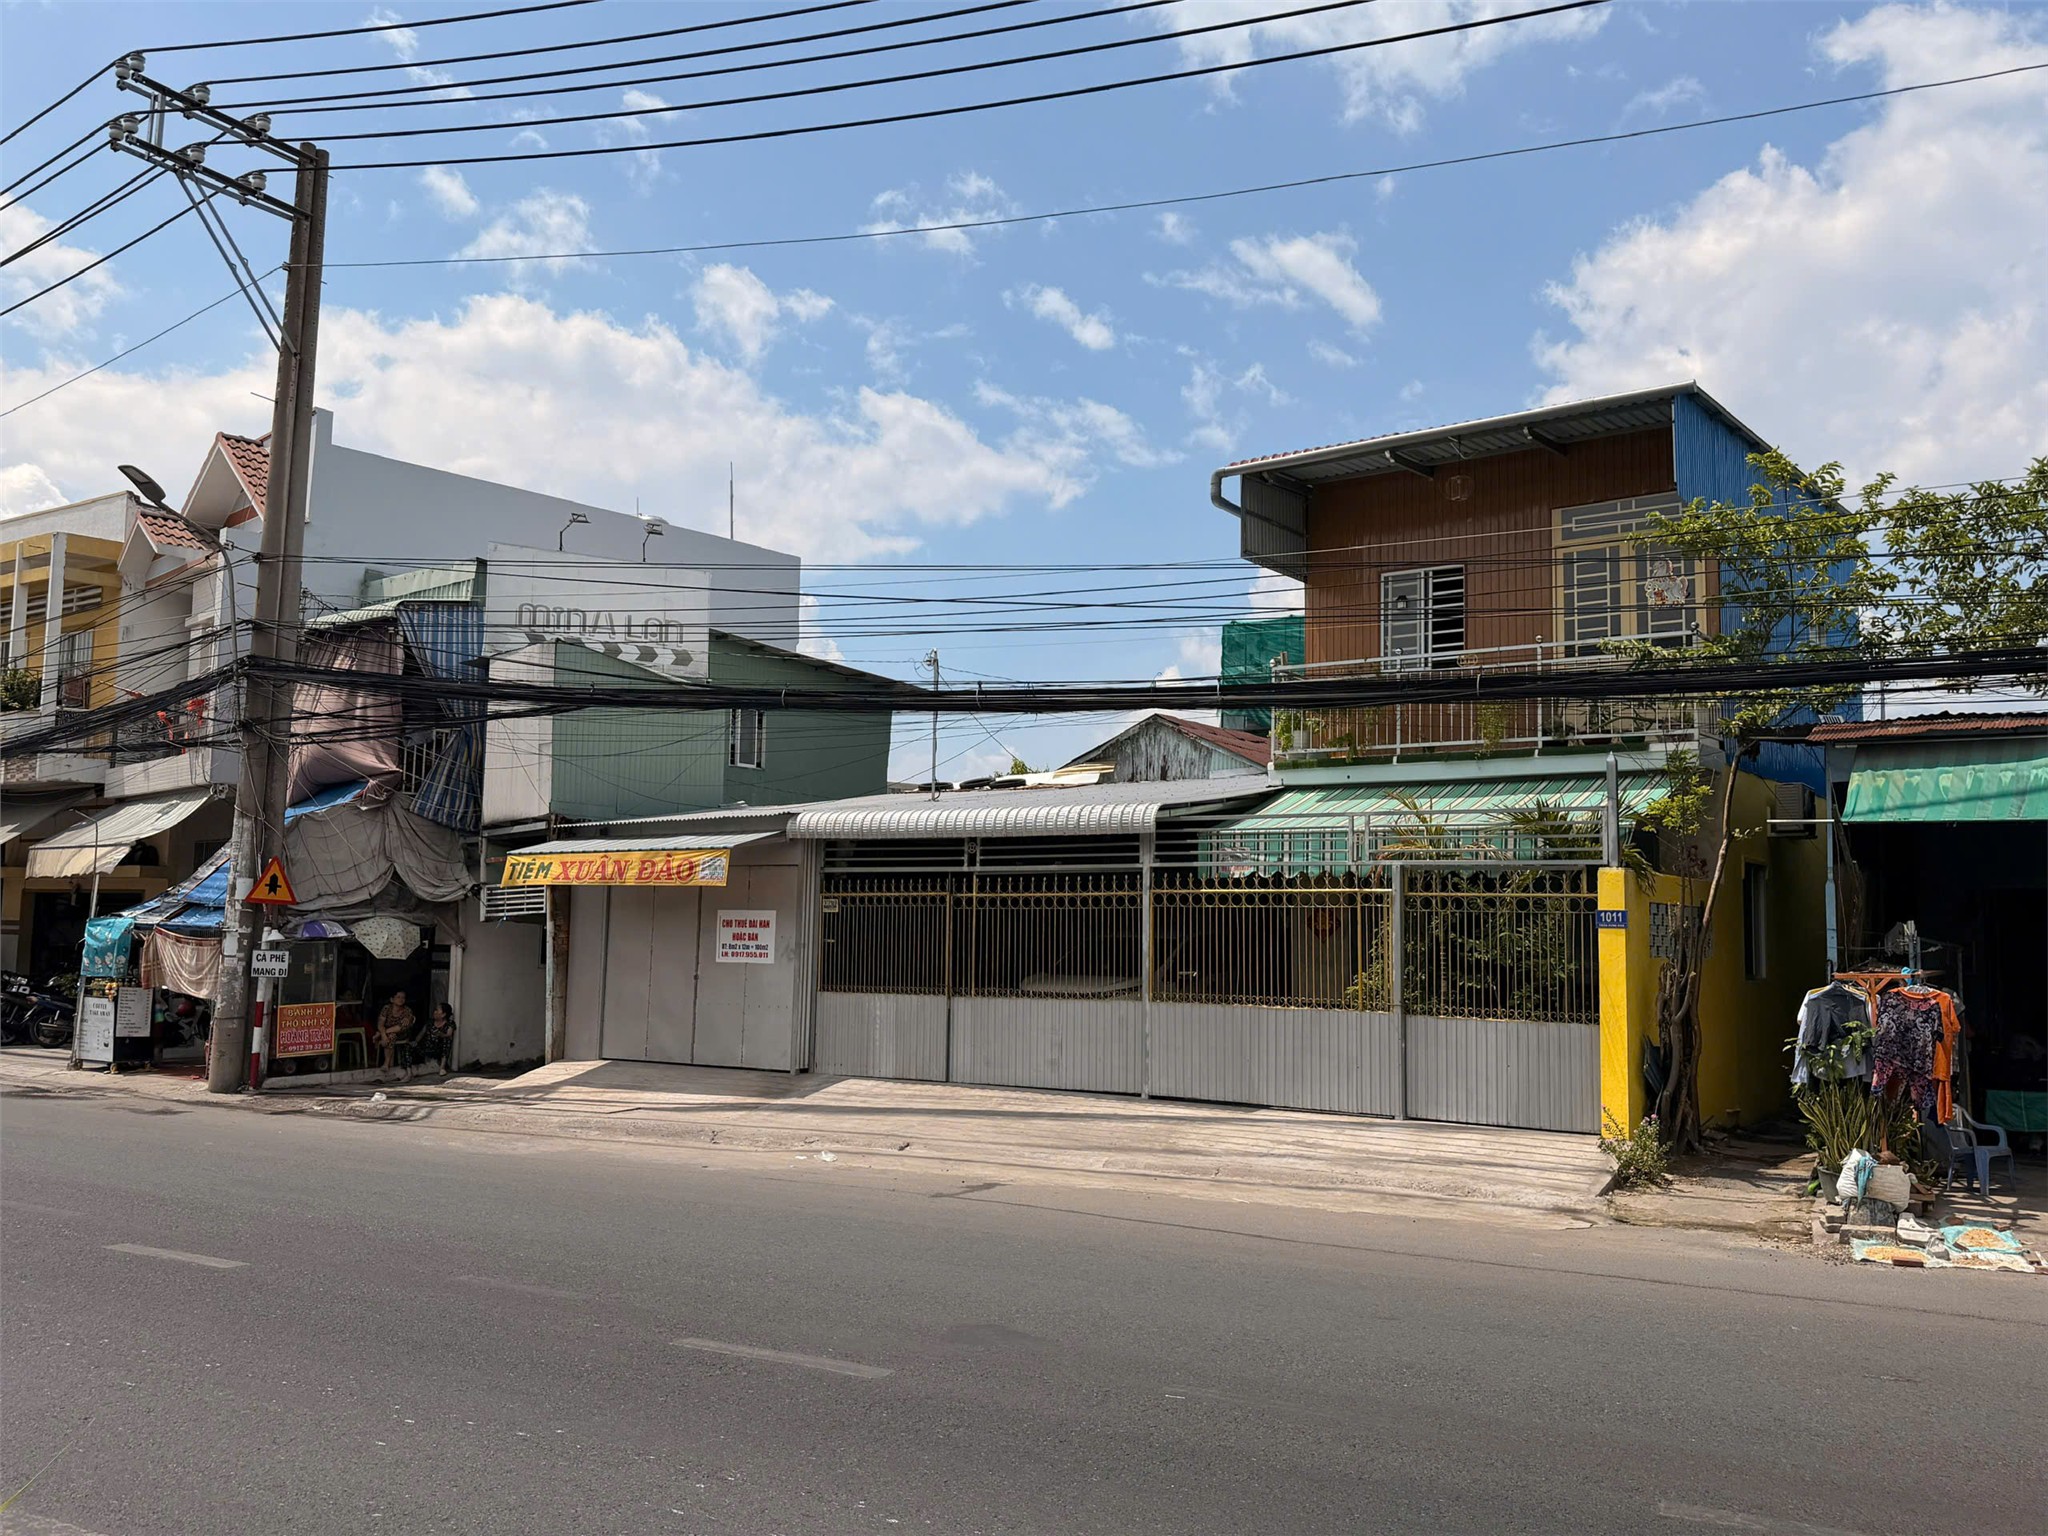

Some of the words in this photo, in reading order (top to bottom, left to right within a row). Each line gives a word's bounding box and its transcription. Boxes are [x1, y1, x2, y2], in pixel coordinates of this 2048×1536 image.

[508, 858, 553, 884] TIỆM
[552, 854, 632, 883] XUÂN
[635, 852, 697, 883] ĐÀO
[1600, 911, 1622, 922] 1011
[252, 967, 276, 976] MANG
